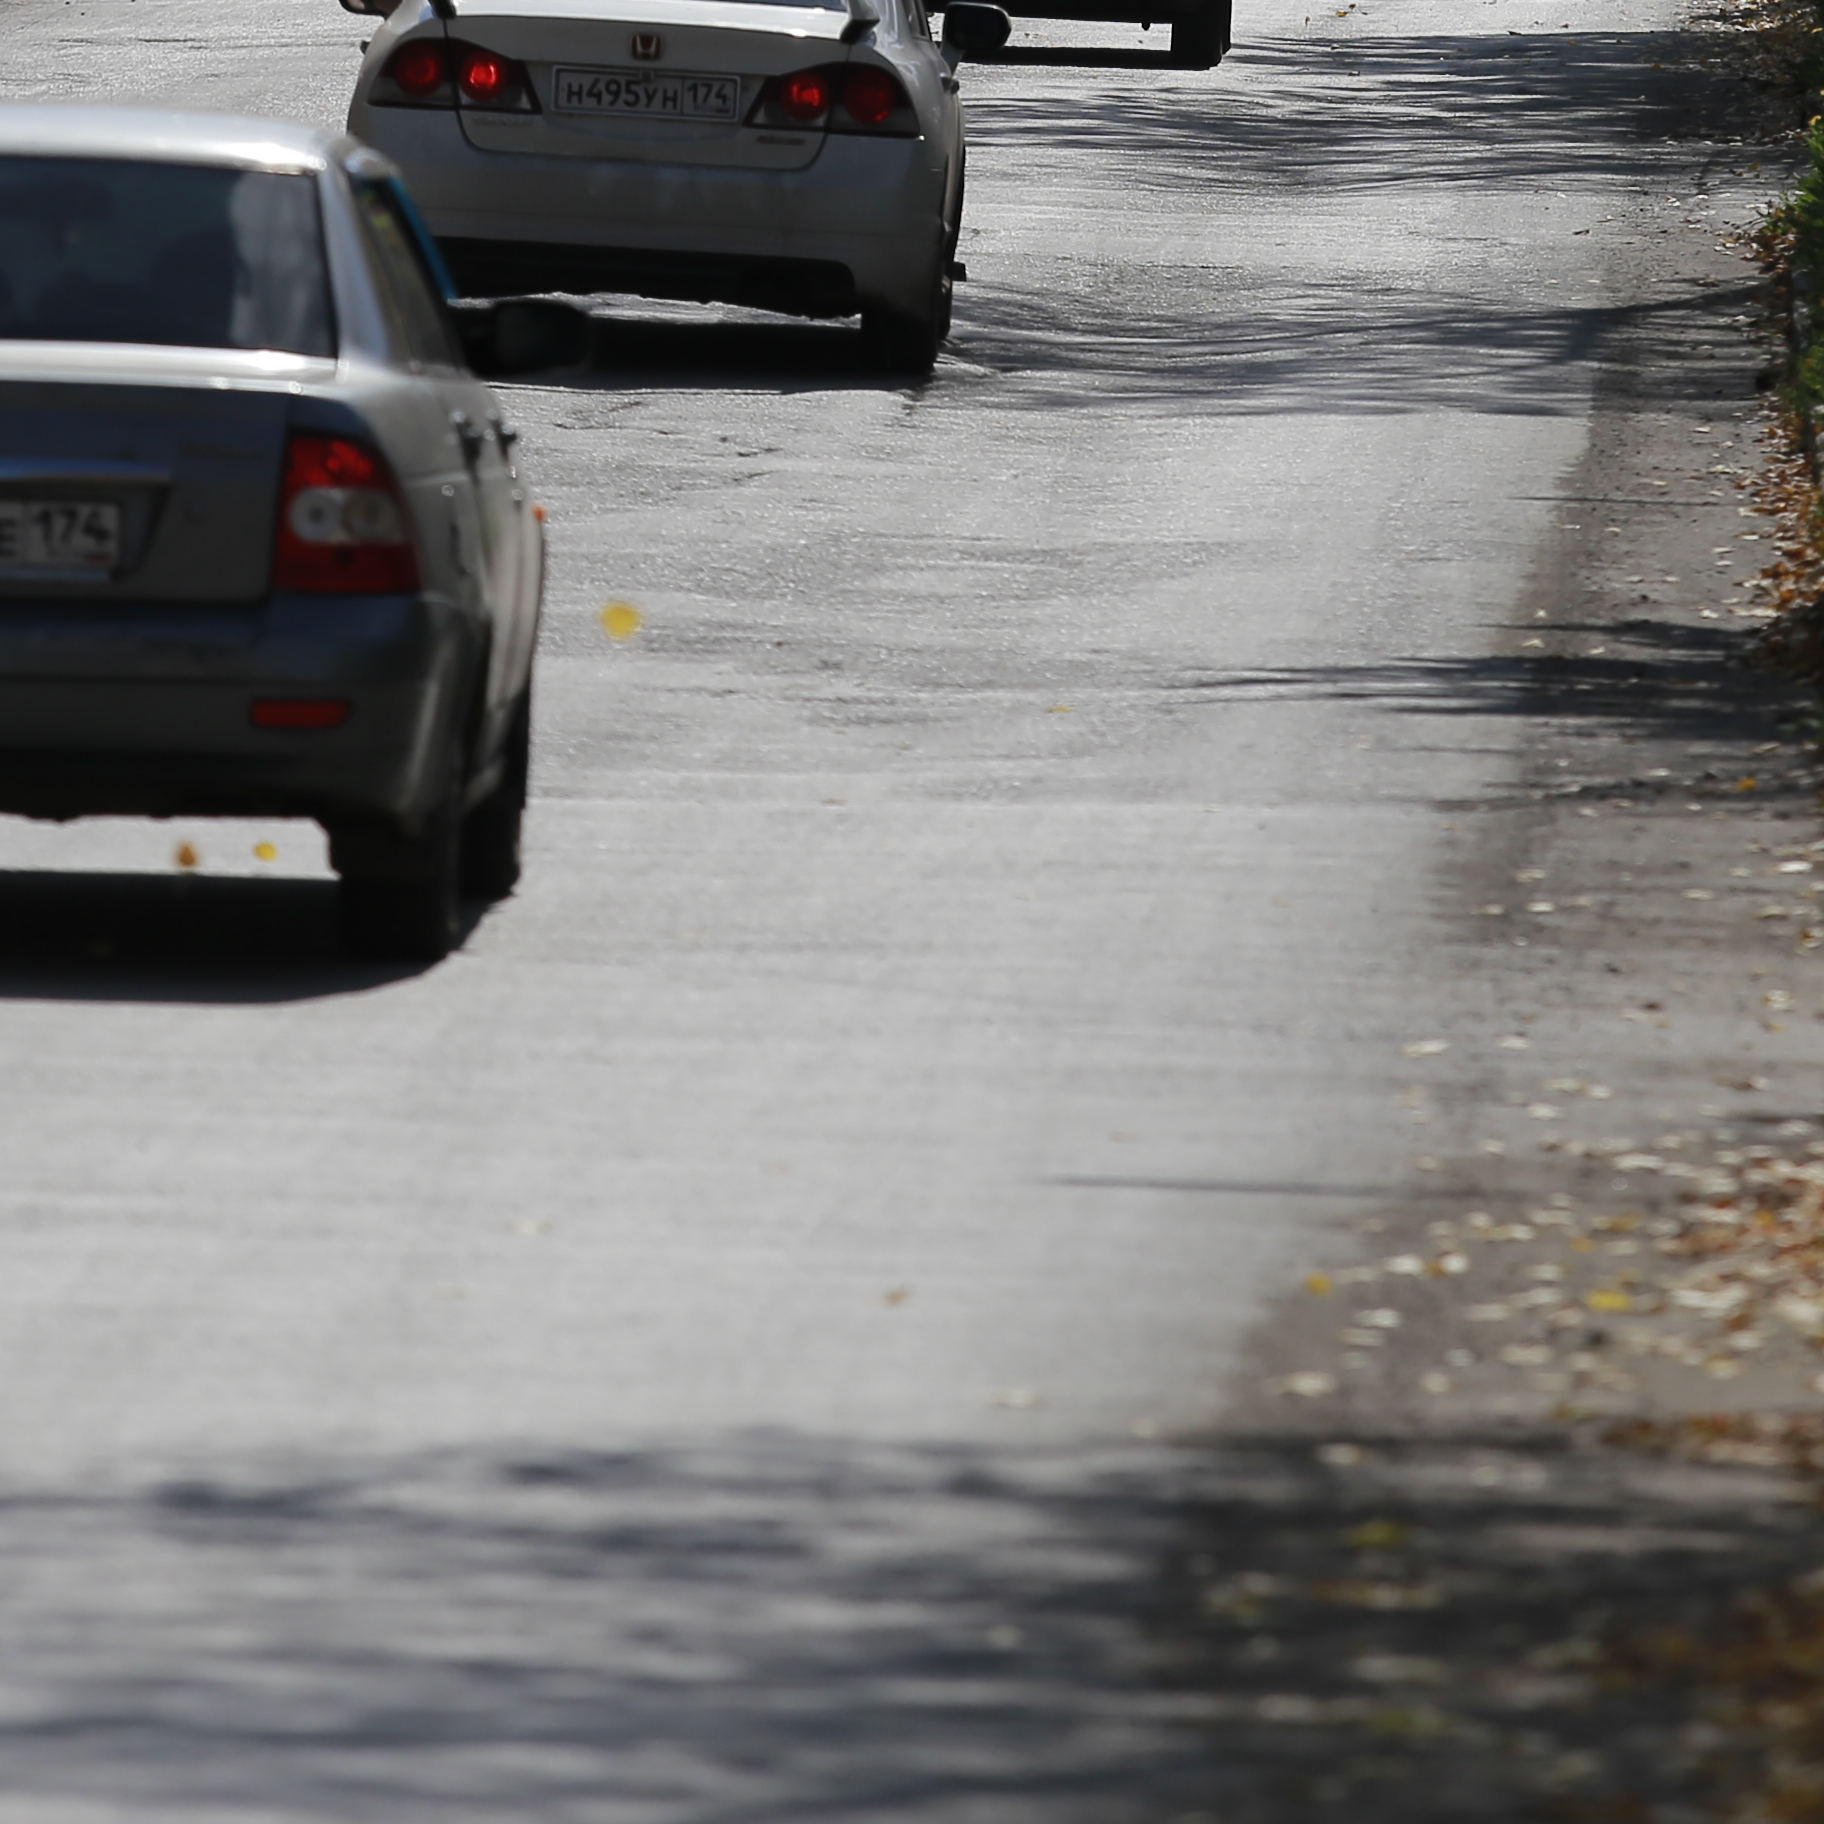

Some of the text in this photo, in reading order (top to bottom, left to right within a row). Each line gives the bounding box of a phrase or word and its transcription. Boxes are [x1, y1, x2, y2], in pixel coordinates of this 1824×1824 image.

[567, 78, 729, 110] Н495УН 174
[31, 507, 112, 549] 174
